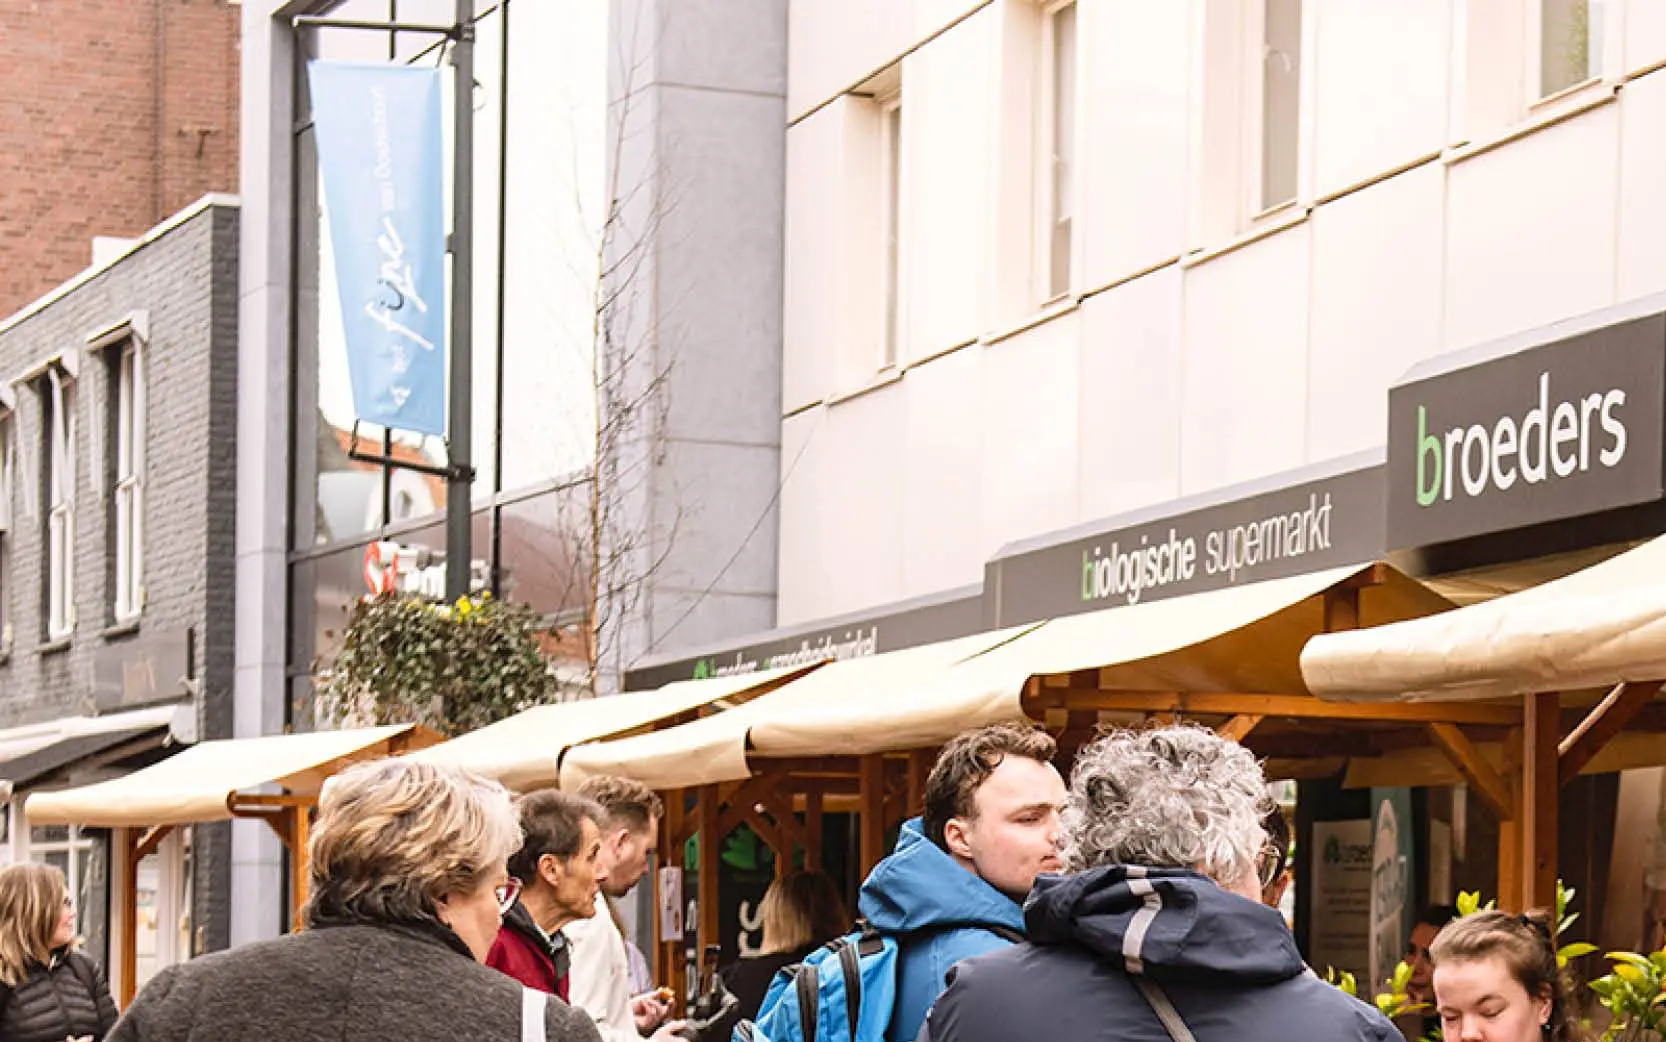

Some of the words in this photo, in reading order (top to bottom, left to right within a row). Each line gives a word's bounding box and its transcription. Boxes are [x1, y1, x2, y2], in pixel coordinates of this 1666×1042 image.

[1416, 372, 1626, 507] broeders
[1082, 527, 1195, 604] biologische
[1205, 493, 1332, 581] supermarkt
